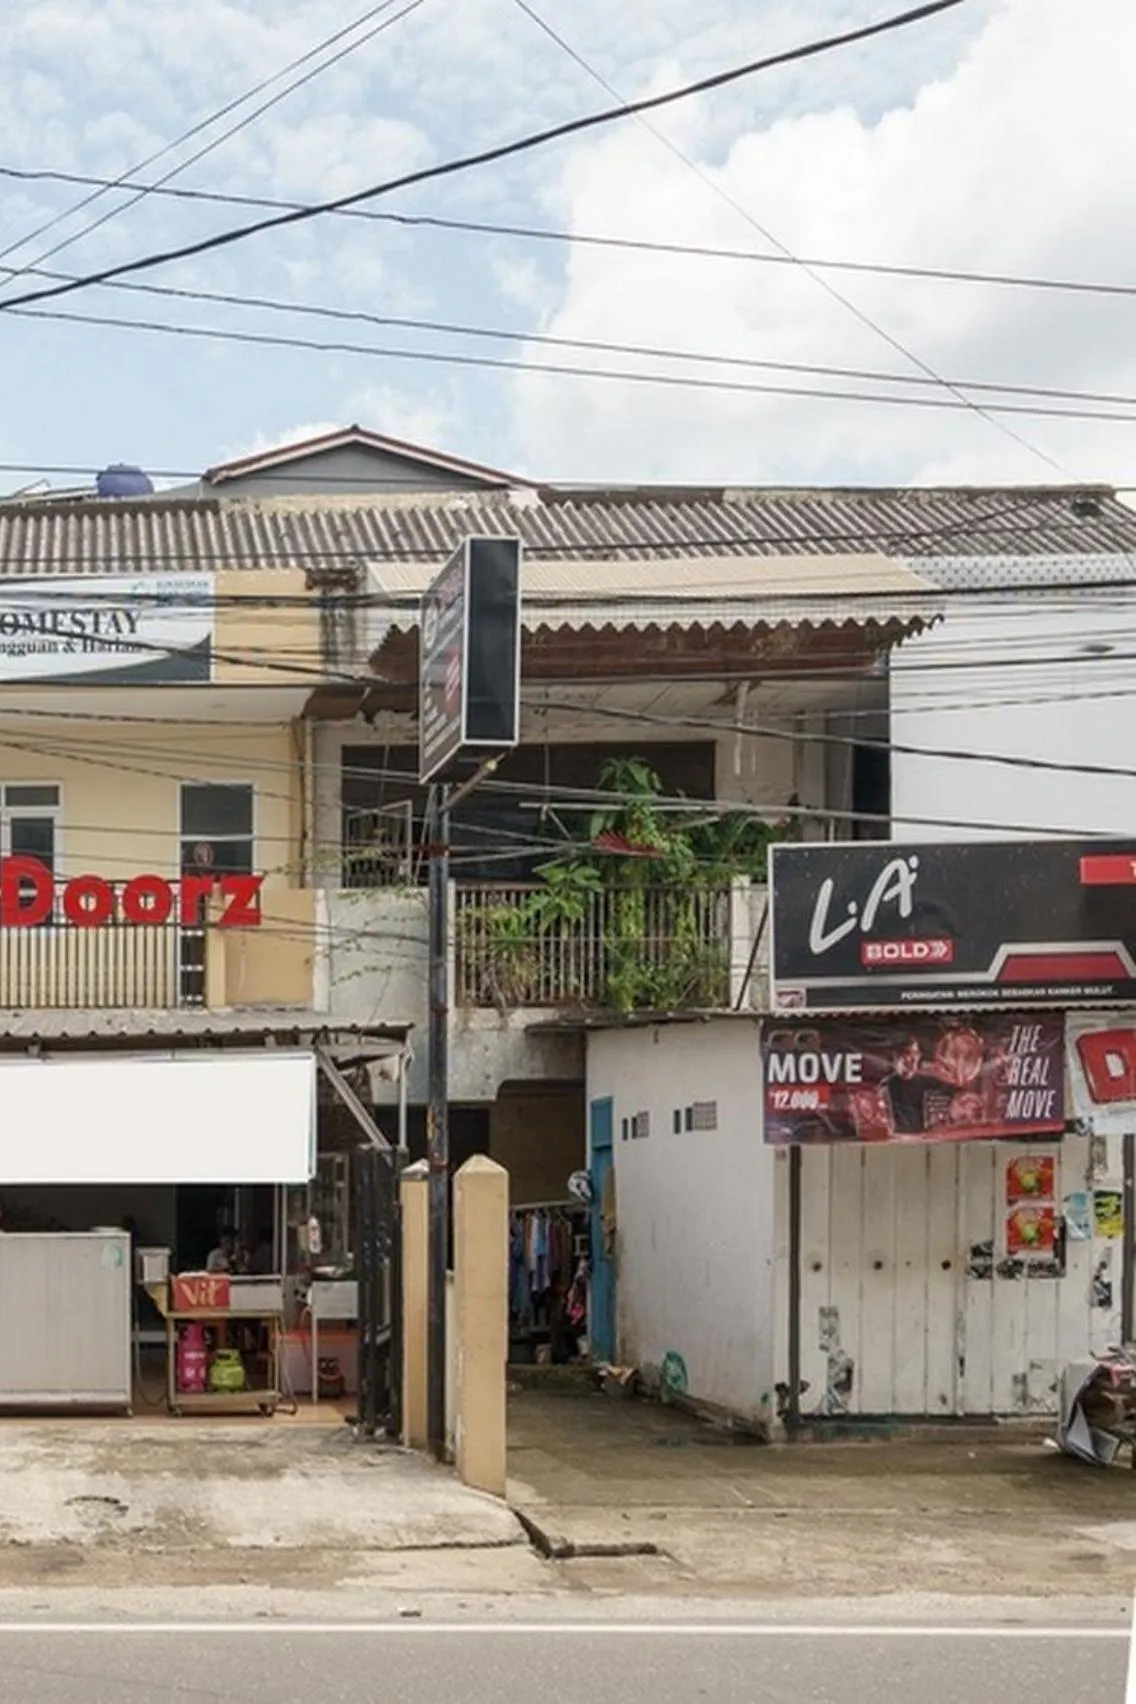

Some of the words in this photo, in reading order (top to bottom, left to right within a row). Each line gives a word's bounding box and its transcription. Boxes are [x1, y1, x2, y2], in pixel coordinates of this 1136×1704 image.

[62, 639, 75, 653] &
[867, 942, 929, 959] BOLD
[1009, 1024, 1043, 1056] THE
[768, 1053, 862, 1083] MOVE
[1007, 1056, 1049, 1086] REAL
[1006, 1090, 1056, 1118] MOVE
[179, 1279, 222, 1305] Vit
